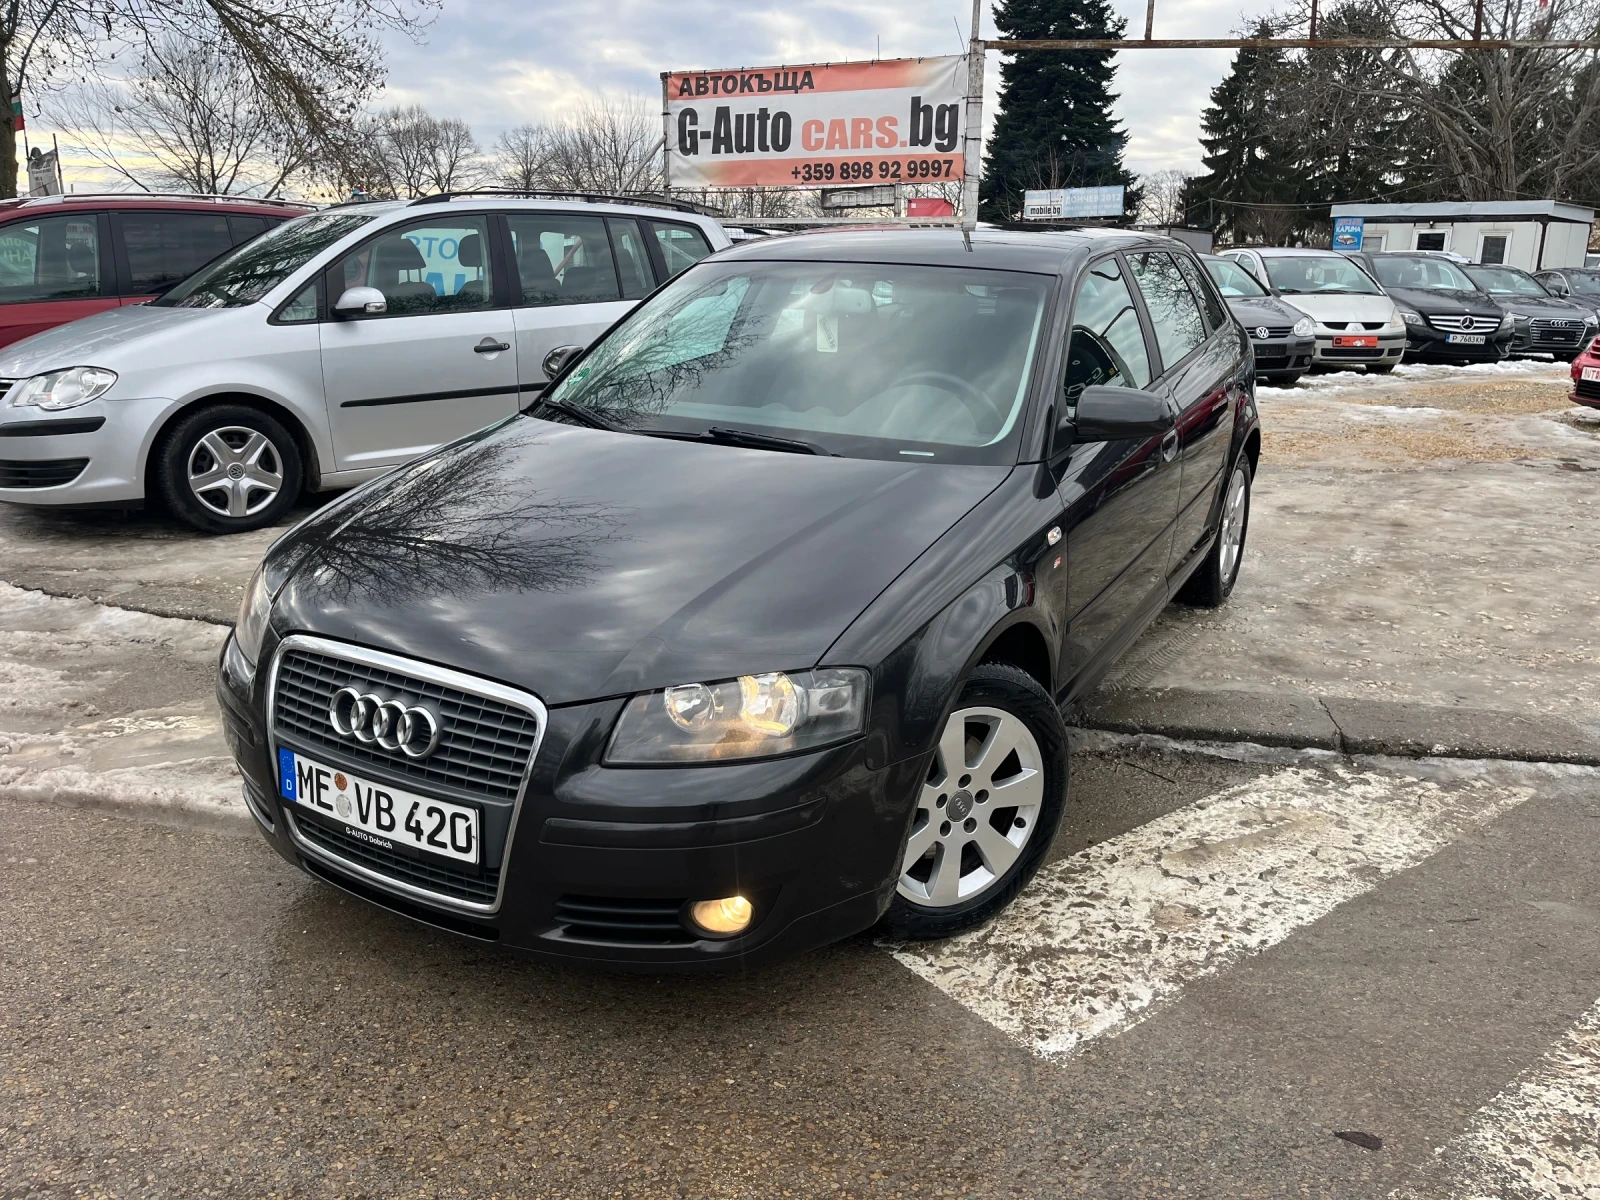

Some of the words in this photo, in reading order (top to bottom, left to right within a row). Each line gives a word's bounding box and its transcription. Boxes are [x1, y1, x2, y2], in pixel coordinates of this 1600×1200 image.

[678, 70, 815, 97] АВТОКЪЩА
[677, 105, 792, 157] G-Auto
[791, 163, 835, 181] +359
[839, 162, 873, 180] 898
[879, 161, 901, 179] 92
[907, 159, 954, 178] 9997
[1101, 193, 1121, 202] 2012
[286, 779, 292, 791] D
[297, 760, 333, 812] ME
[354, 781, 396, 833] VB
[404, 800, 473, 854] 420
[345, 826, 368, 841] G-AUTO
[368, 835, 393, 850] Dobrich
